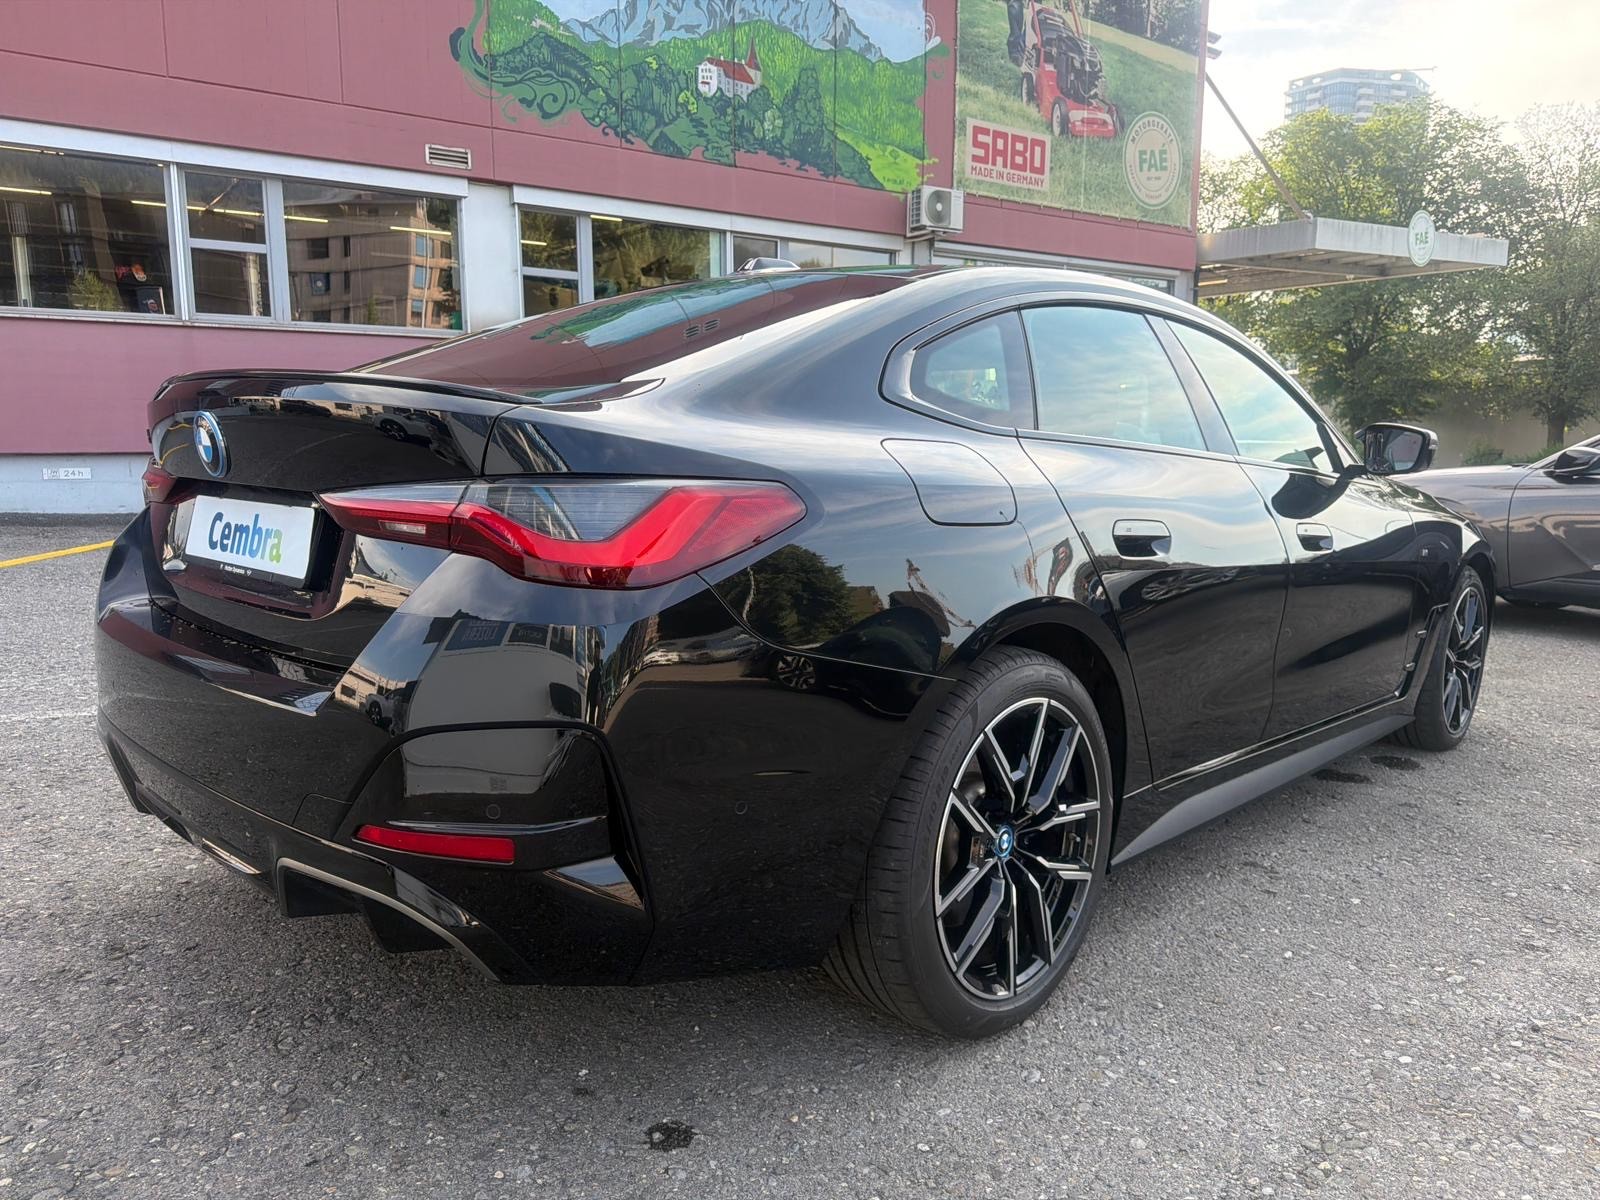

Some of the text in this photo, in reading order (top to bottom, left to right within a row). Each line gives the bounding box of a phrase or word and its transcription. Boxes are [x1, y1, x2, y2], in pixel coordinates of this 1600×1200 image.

[971, 125, 1047, 176] SABO
[1138, 142, 1169, 172] FAÉ
[970, 165, 1045, 188] MADE IN GERMANY
[208, 511, 283, 564] Cembra
